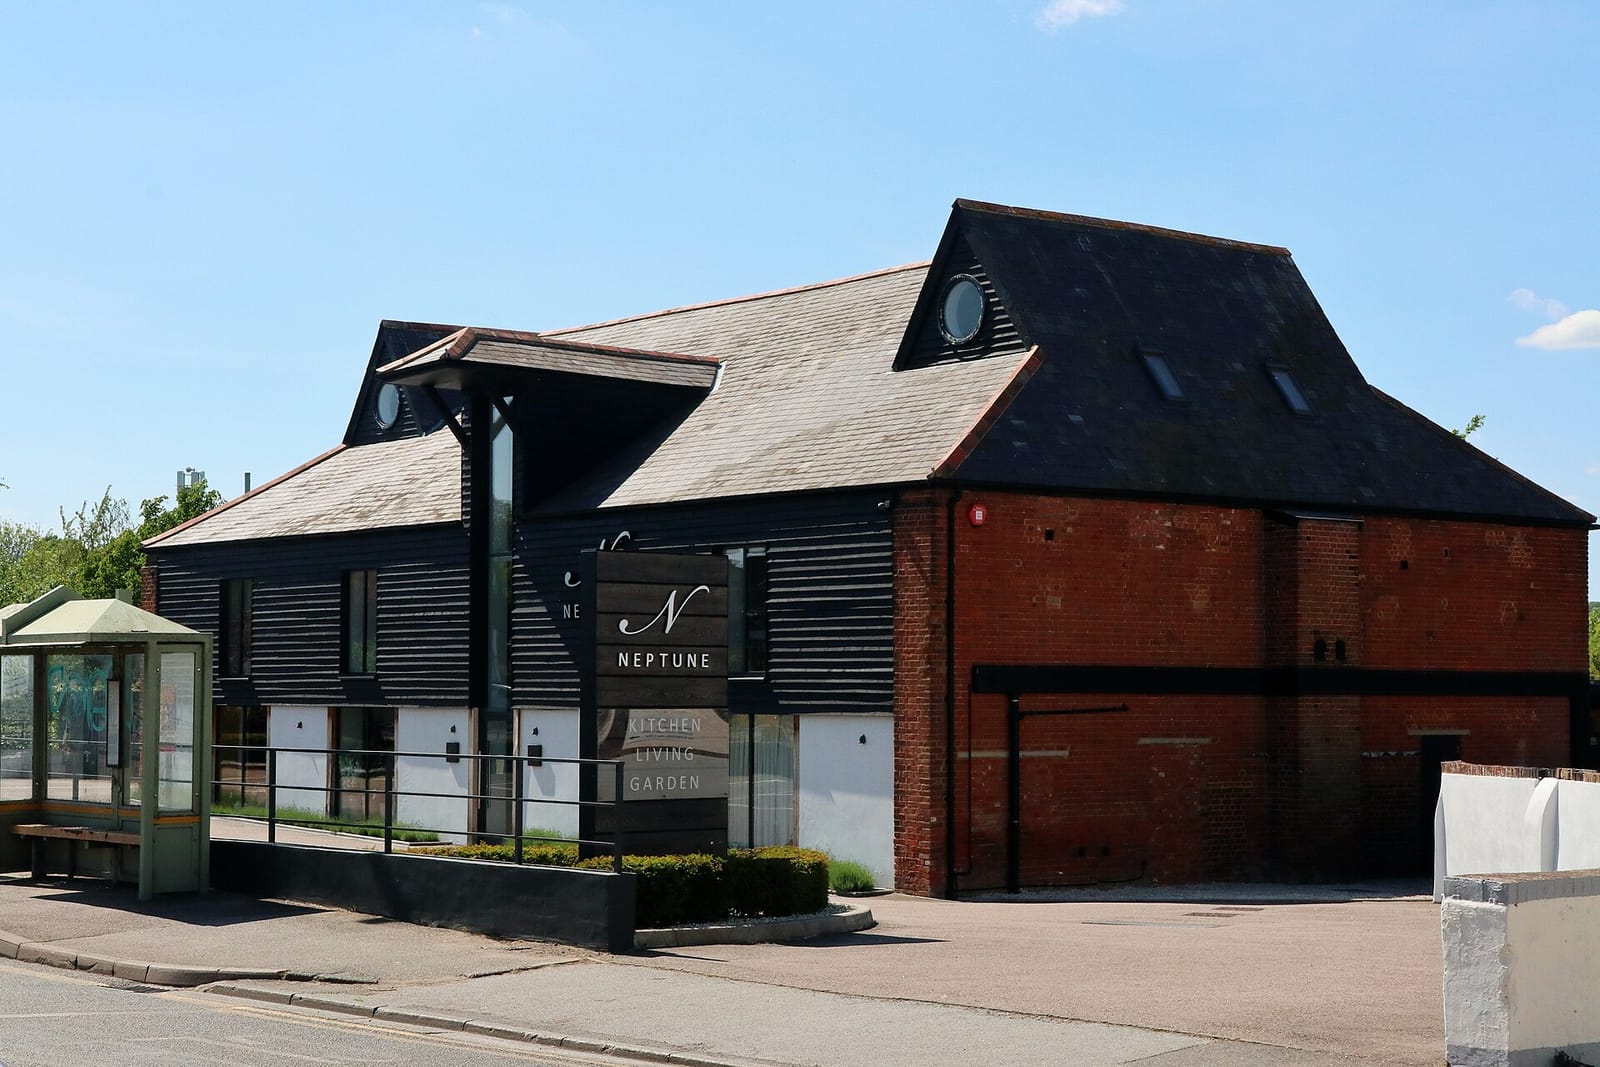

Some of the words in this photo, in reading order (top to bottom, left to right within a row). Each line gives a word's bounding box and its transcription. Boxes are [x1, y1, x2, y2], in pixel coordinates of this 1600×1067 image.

[618, 585, 710, 635] N
[618, 652, 710, 668] NEPTUNE
[629, 718, 701, 733] KITCHEN
[636, 746, 694, 762] LIVING
[630, 775, 699, 791] GARDEN
